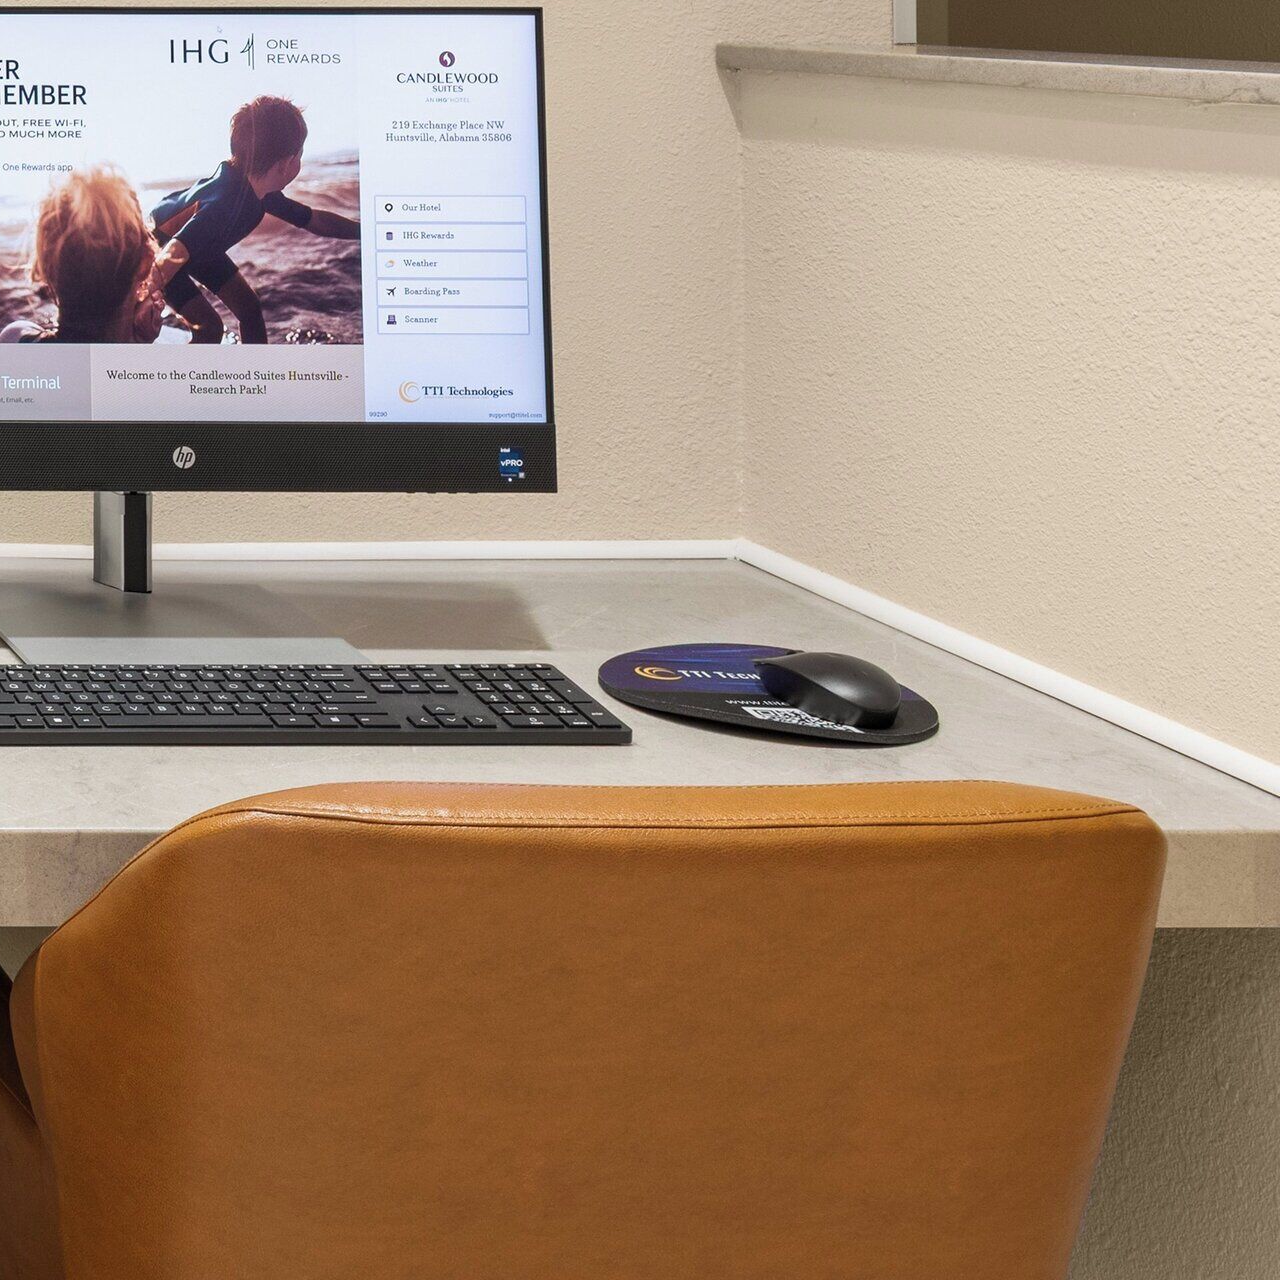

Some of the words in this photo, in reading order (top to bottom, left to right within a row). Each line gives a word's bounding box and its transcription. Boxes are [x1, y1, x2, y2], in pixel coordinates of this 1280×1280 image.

[266, 38, 299, 50] ONE
[171, 39, 228, 63] IHG
[266, 53, 341, 64] REWARDS
[396, 72, 499, 84] CANDLEWOOD
[432, 84, 464, 93] SUITES
[22, 118, 52, 127] FREE
[54, 118, 87, 128] WI-FI,
[391, 120, 411, 130] 219
[412, 119, 458, 132] Exchange
[459, 120, 485, 130] Place
[486, 120, 505, 130] NW
[8, 130, 45, 139] MUCH
[47, 130, 82, 139] MORE
[385, 132, 437, 143] Huntsville,
[438, 132, 480, 142] Alabama
[481, 132, 513, 143] 35806
[1, 162, 20, 172] One
[21, 162, 56, 172] Rewards
[57, 164, 74, 175] app
[401, 203, 419, 212] Our
[419, 202, 442, 212] Hotel
[402, 231, 419, 240] IHG
[420, 231, 455, 240] Rewards
[402, 258, 438, 268] Weather
[404, 286, 441, 297] Boarding
[442, 287, 461, 296] Pass
[404, 314, 439, 324] Scanner
[106, 369, 155, 380] Welcome
[156, 371, 168, 380] to
[169, 369, 187, 381] the
[188, 369, 252, 381] Candlewood
[253, 370, 286, 381] Suites
[288, 370, 343, 381] Huntsville
[1, 376, 61, 389] Terminal
[189, 384, 237, 395] Research
[239, 384, 267, 395] Park!
[421, 385, 444, 396] TTI
[446, 386, 514, 399] Technologies
[175, 446, 193, 469] hp
[500, 459, 523, 467] vPRO
[677, 670, 711, 678] TTI
